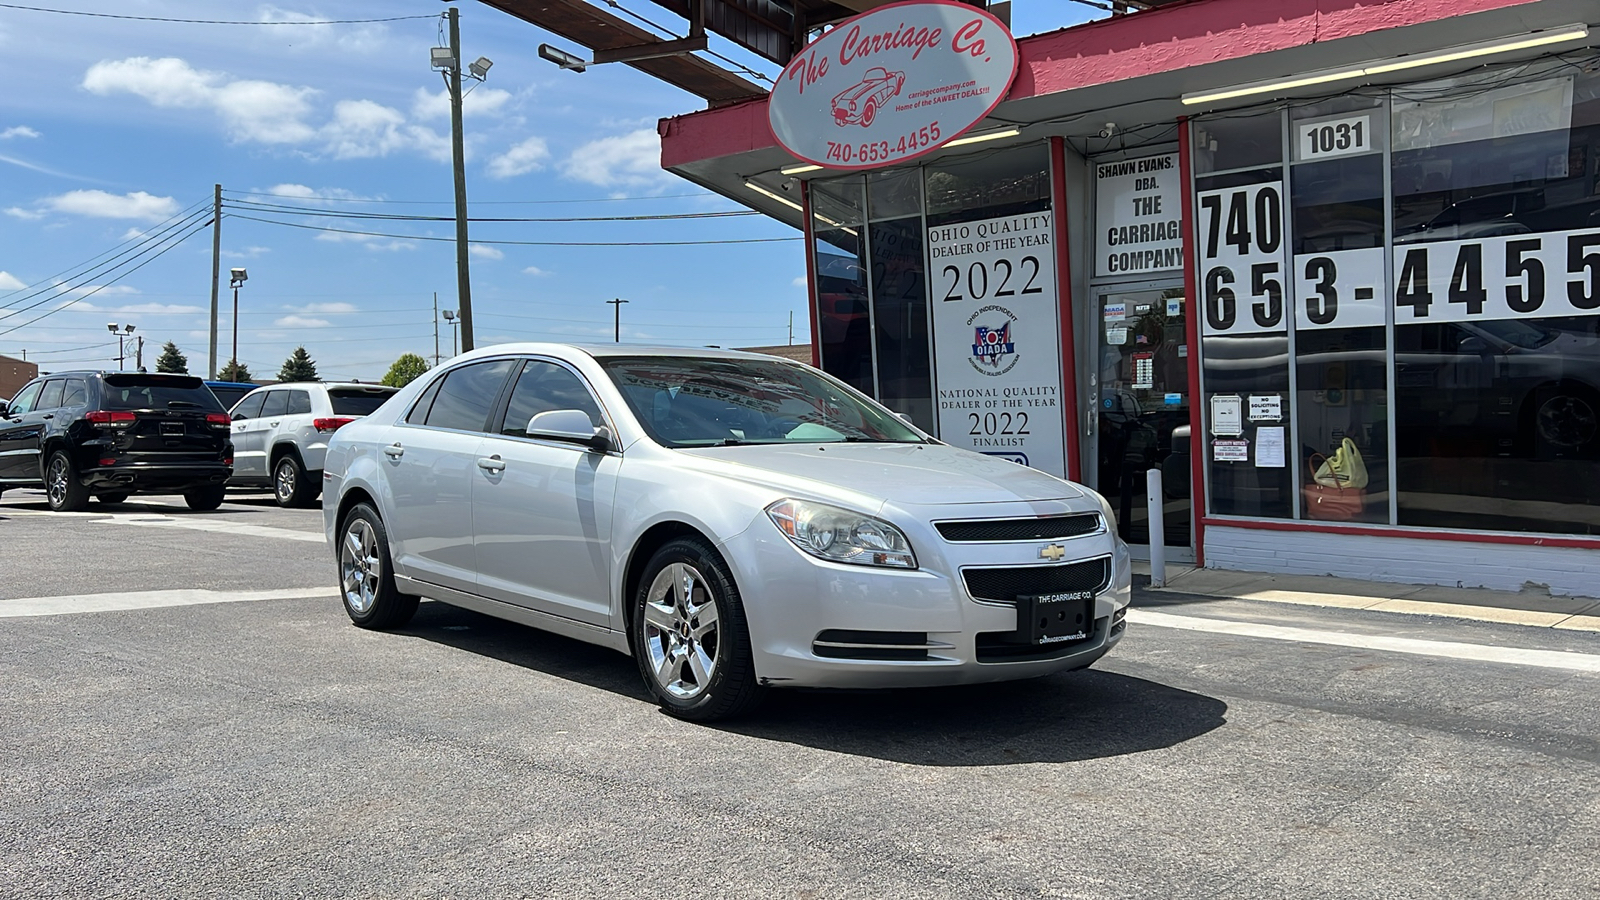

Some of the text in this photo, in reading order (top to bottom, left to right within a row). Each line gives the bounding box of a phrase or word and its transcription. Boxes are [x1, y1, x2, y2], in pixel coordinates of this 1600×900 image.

[789, 18, 992, 94] The Carriage Co.
[895, 86, 990, 112] Home of the SAWEET DEALS!!!
[908, 80, 976, 99] carriagecompany.com
[826, 120, 941, 163] 740-653-4455
[1307, 121, 1363, 153] 1031
[1098, 156, 1174, 179] SHAWN EVANS.
[1135, 177, 1160, 191] DBA.
[1132, 195, 1162, 217] THE
[930, 226, 970, 243] OHIO
[977, 214, 1051, 239] QUALITY
[1201, 187, 1281, 259] 740
[932, 243, 974, 259] DEALER
[976, 241, 991, 253] OF
[993, 237, 1016, 251] THE
[1018, 233, 1050, 248] YEAR
[1108, 247, 1184, 272] COMPANY
[942, 255, 1043, 303] 2022
[966, 305, 1018, 326] OHIO INDEPENDENT
[977, 344, 1008, 355] OIADA
[940, 386, 1057, 399] NATIONAL QUALITY
[941, 398, 1056, 409] DEALER OF THE YEAR
[968, 411, 1031, 436] 2022
[973, 438, 1025, 446] FINALIST
[1038, 595, 1051, 604] THE
[1051, 592, 1082, 602] CARRIAGE
